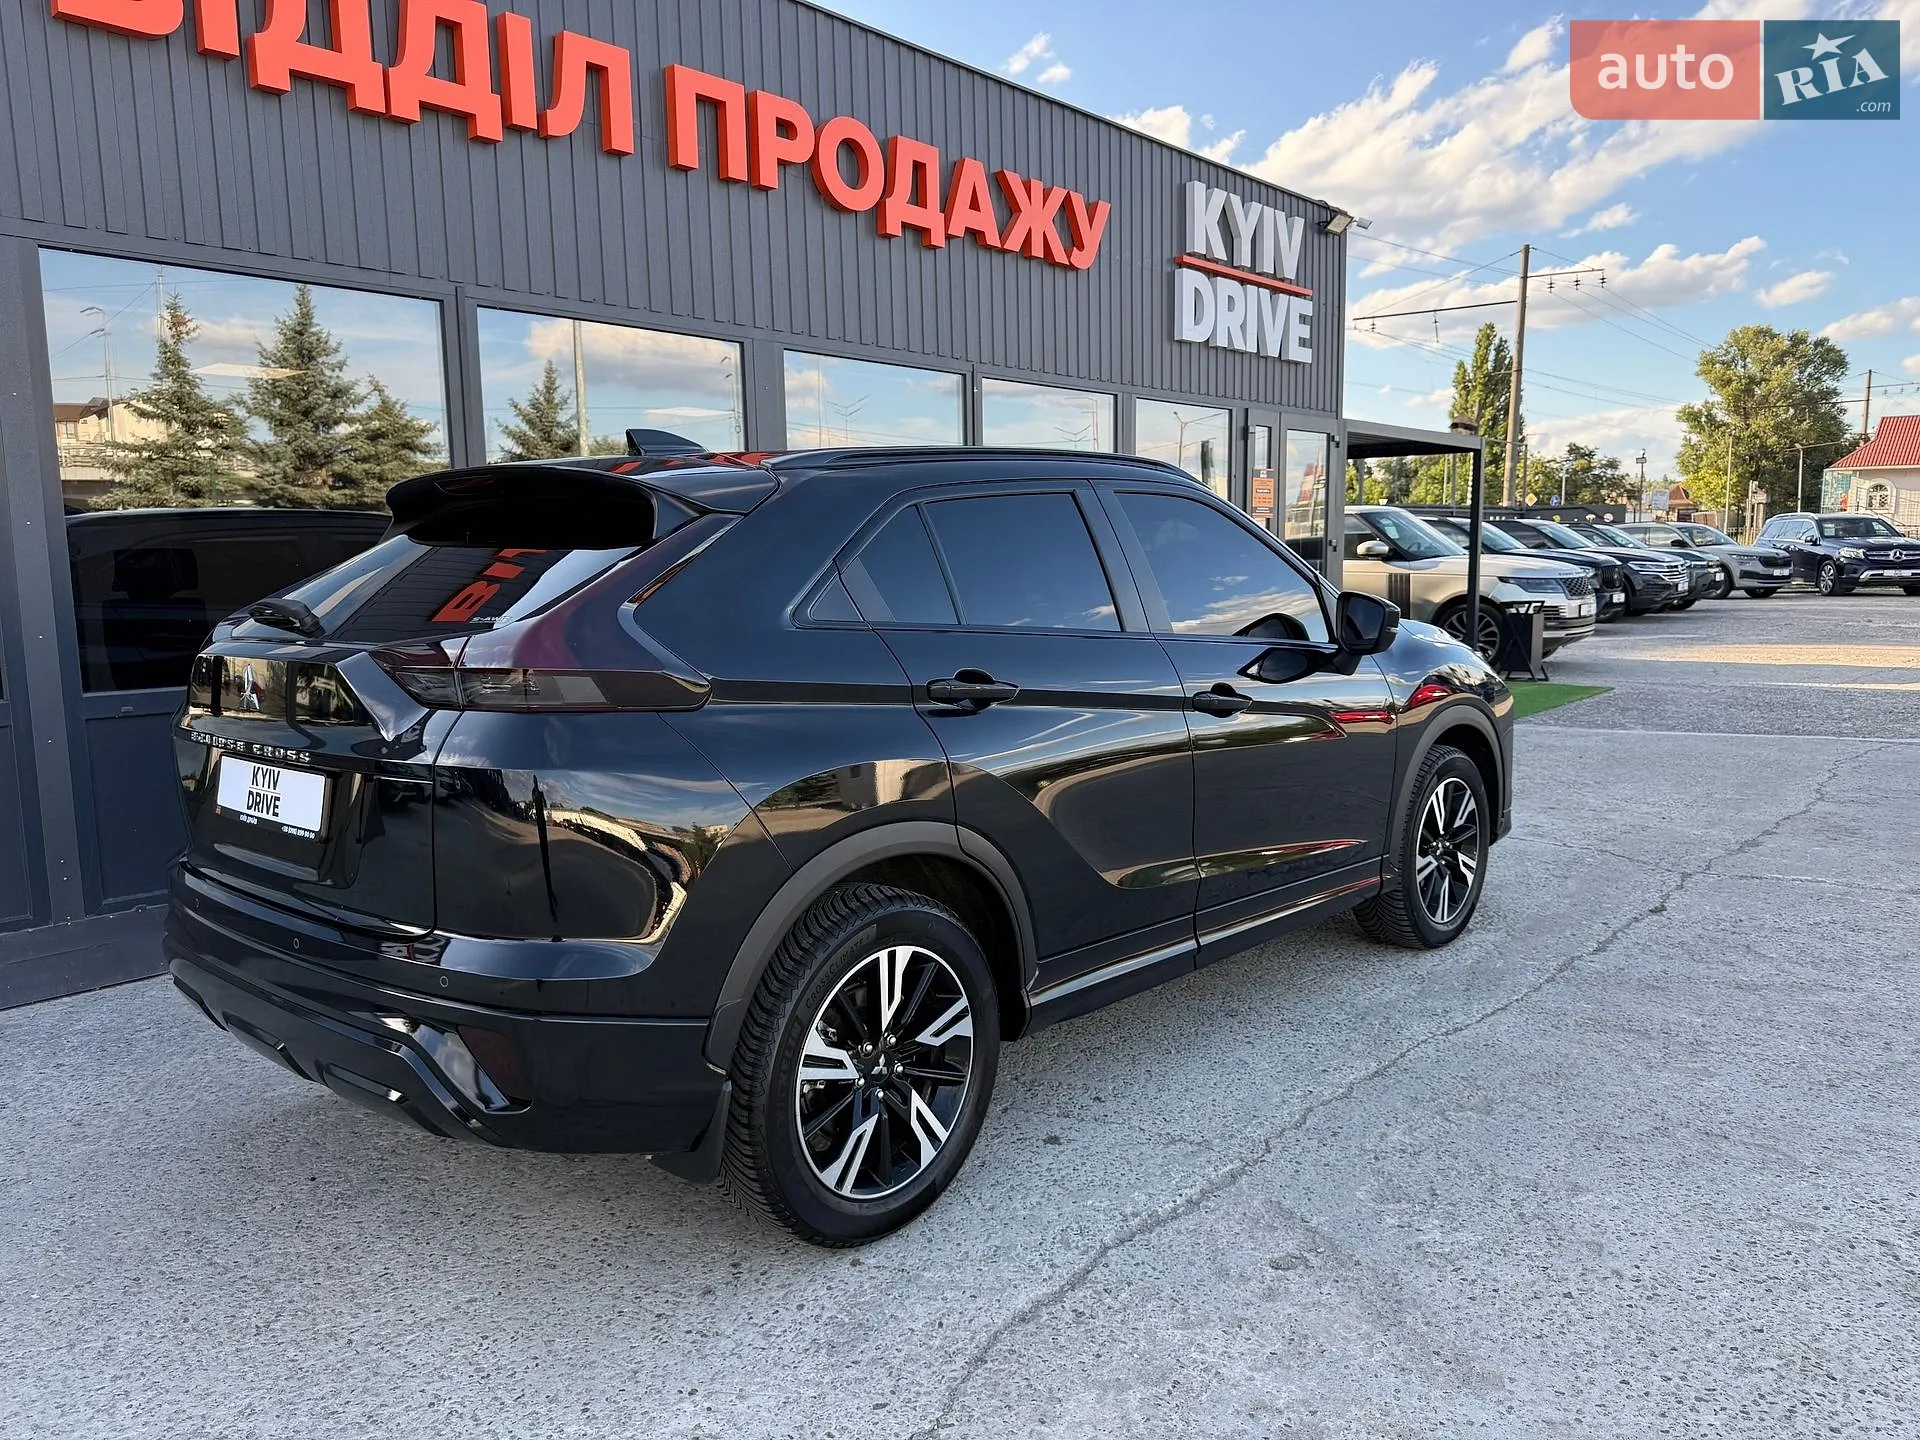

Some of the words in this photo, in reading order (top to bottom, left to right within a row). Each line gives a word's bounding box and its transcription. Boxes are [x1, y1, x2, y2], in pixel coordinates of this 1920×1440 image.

[52, 0, 634, 157] ДДІЛ
[665, 64, 1110, 270] ПРОДАЖУ
[1185, 180, 1304, 280] KYIV
[1174, 268, 1312, 363] DRIVE
[252, 744, 311, 762] CROSS
[252, 765, 281, 790] KYIV
[246, 789, 281, 817] DRIVE
